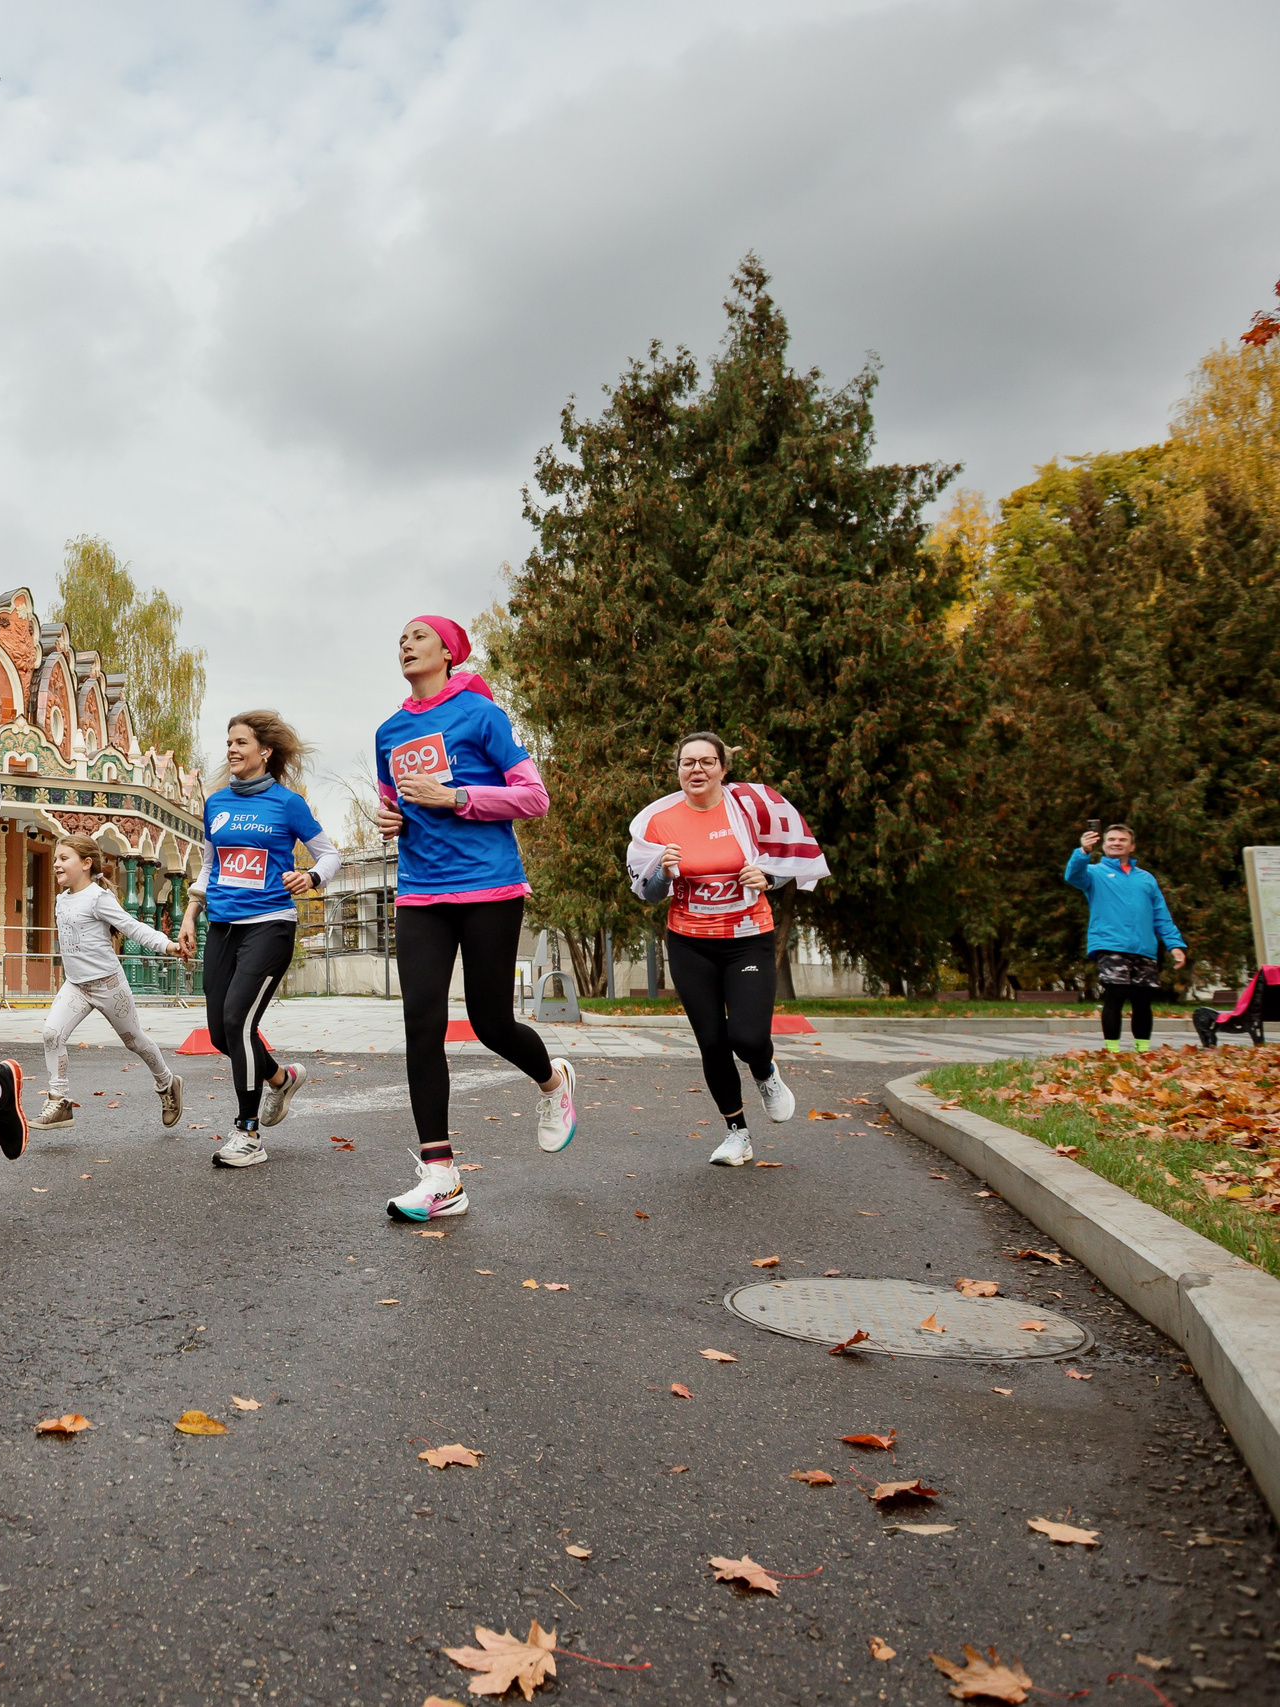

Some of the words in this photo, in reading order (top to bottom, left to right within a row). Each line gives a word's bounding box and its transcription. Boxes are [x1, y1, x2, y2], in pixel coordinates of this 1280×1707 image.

[395, 745, 439, 779] 399
[230, 822, 242, 831] ЗА
[242, 822, 273, 834] ОРБИ
[223, 853, 263, 875] 404
[695, 880, 739, 902] 422
